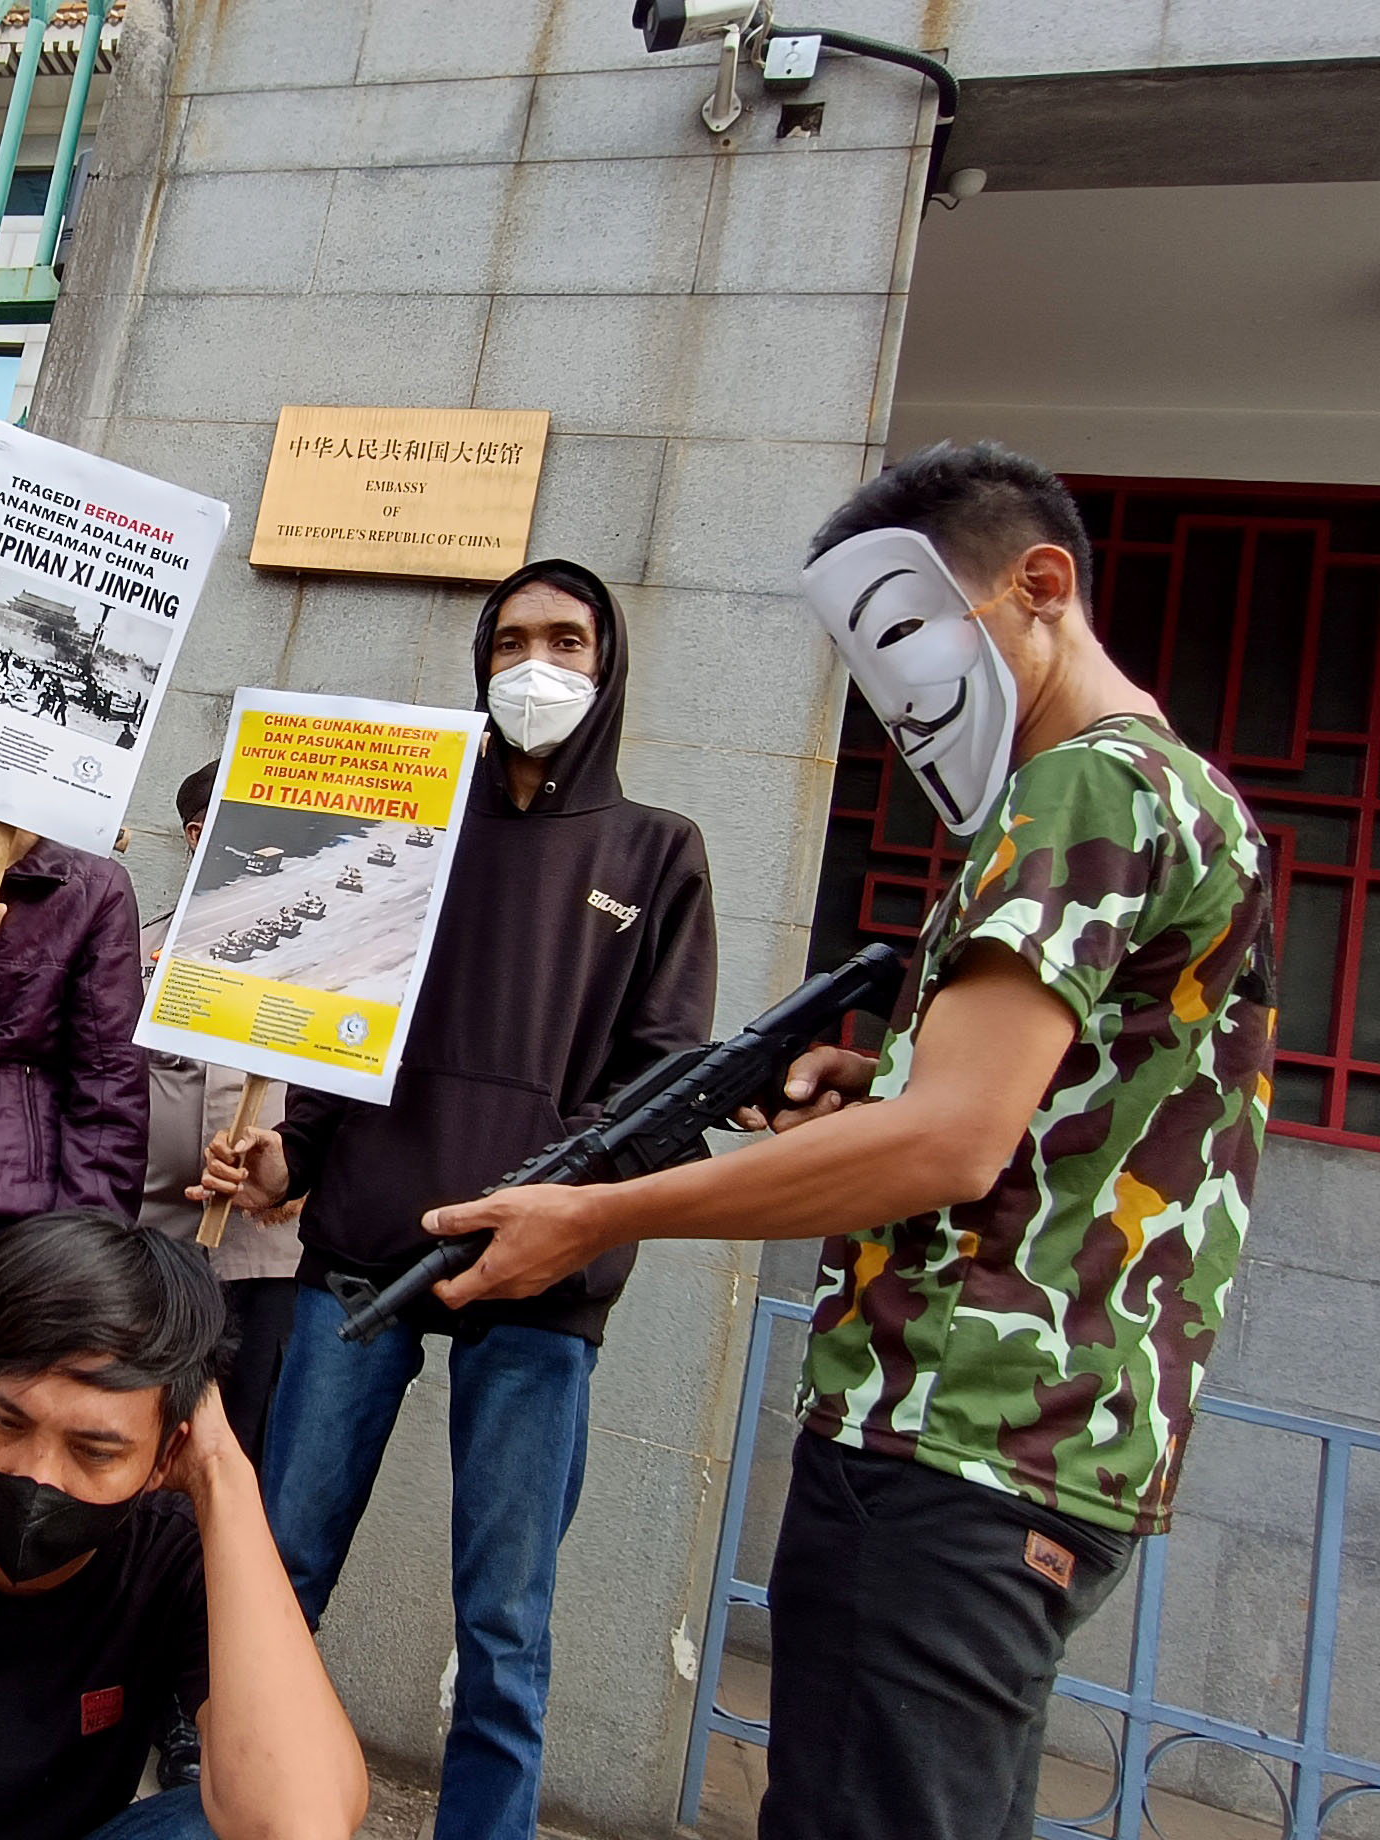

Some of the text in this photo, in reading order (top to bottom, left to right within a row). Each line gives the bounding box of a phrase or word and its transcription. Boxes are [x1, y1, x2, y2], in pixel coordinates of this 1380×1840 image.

[288, 436, 524, 465] 中华人民共和国大使馆
[365, 480, 428, 494] EMBASSY
[11, 475, 175, 544] TRAGEDI BERDARAH
[383, 505, 401, 518] OF
[3, 514, 155, 579] KEKEJAMAN CHINA
[80, 523, 147, 556] ADALAH
[149, 547, 189, 571] BUKI
[277, 524, 502, 549] THE PEOPLE'S REPUBLIC OF CHINA
[70, 559, 95, 589] XI
[94, 570, 180, 620] JINPING
[264, 715, 438, 742] CHINA GUNAKAN MESIN
[263, 731, 431, 759] DAN PASUKAN MILITER
[241, 746, 448, 780] UNTUK CABUT PAKSA NYAWA
[263, 765, 413, 793] RIBUAN MAHASISWA
[249, 783, 419, 820] DI TIANANMEN
